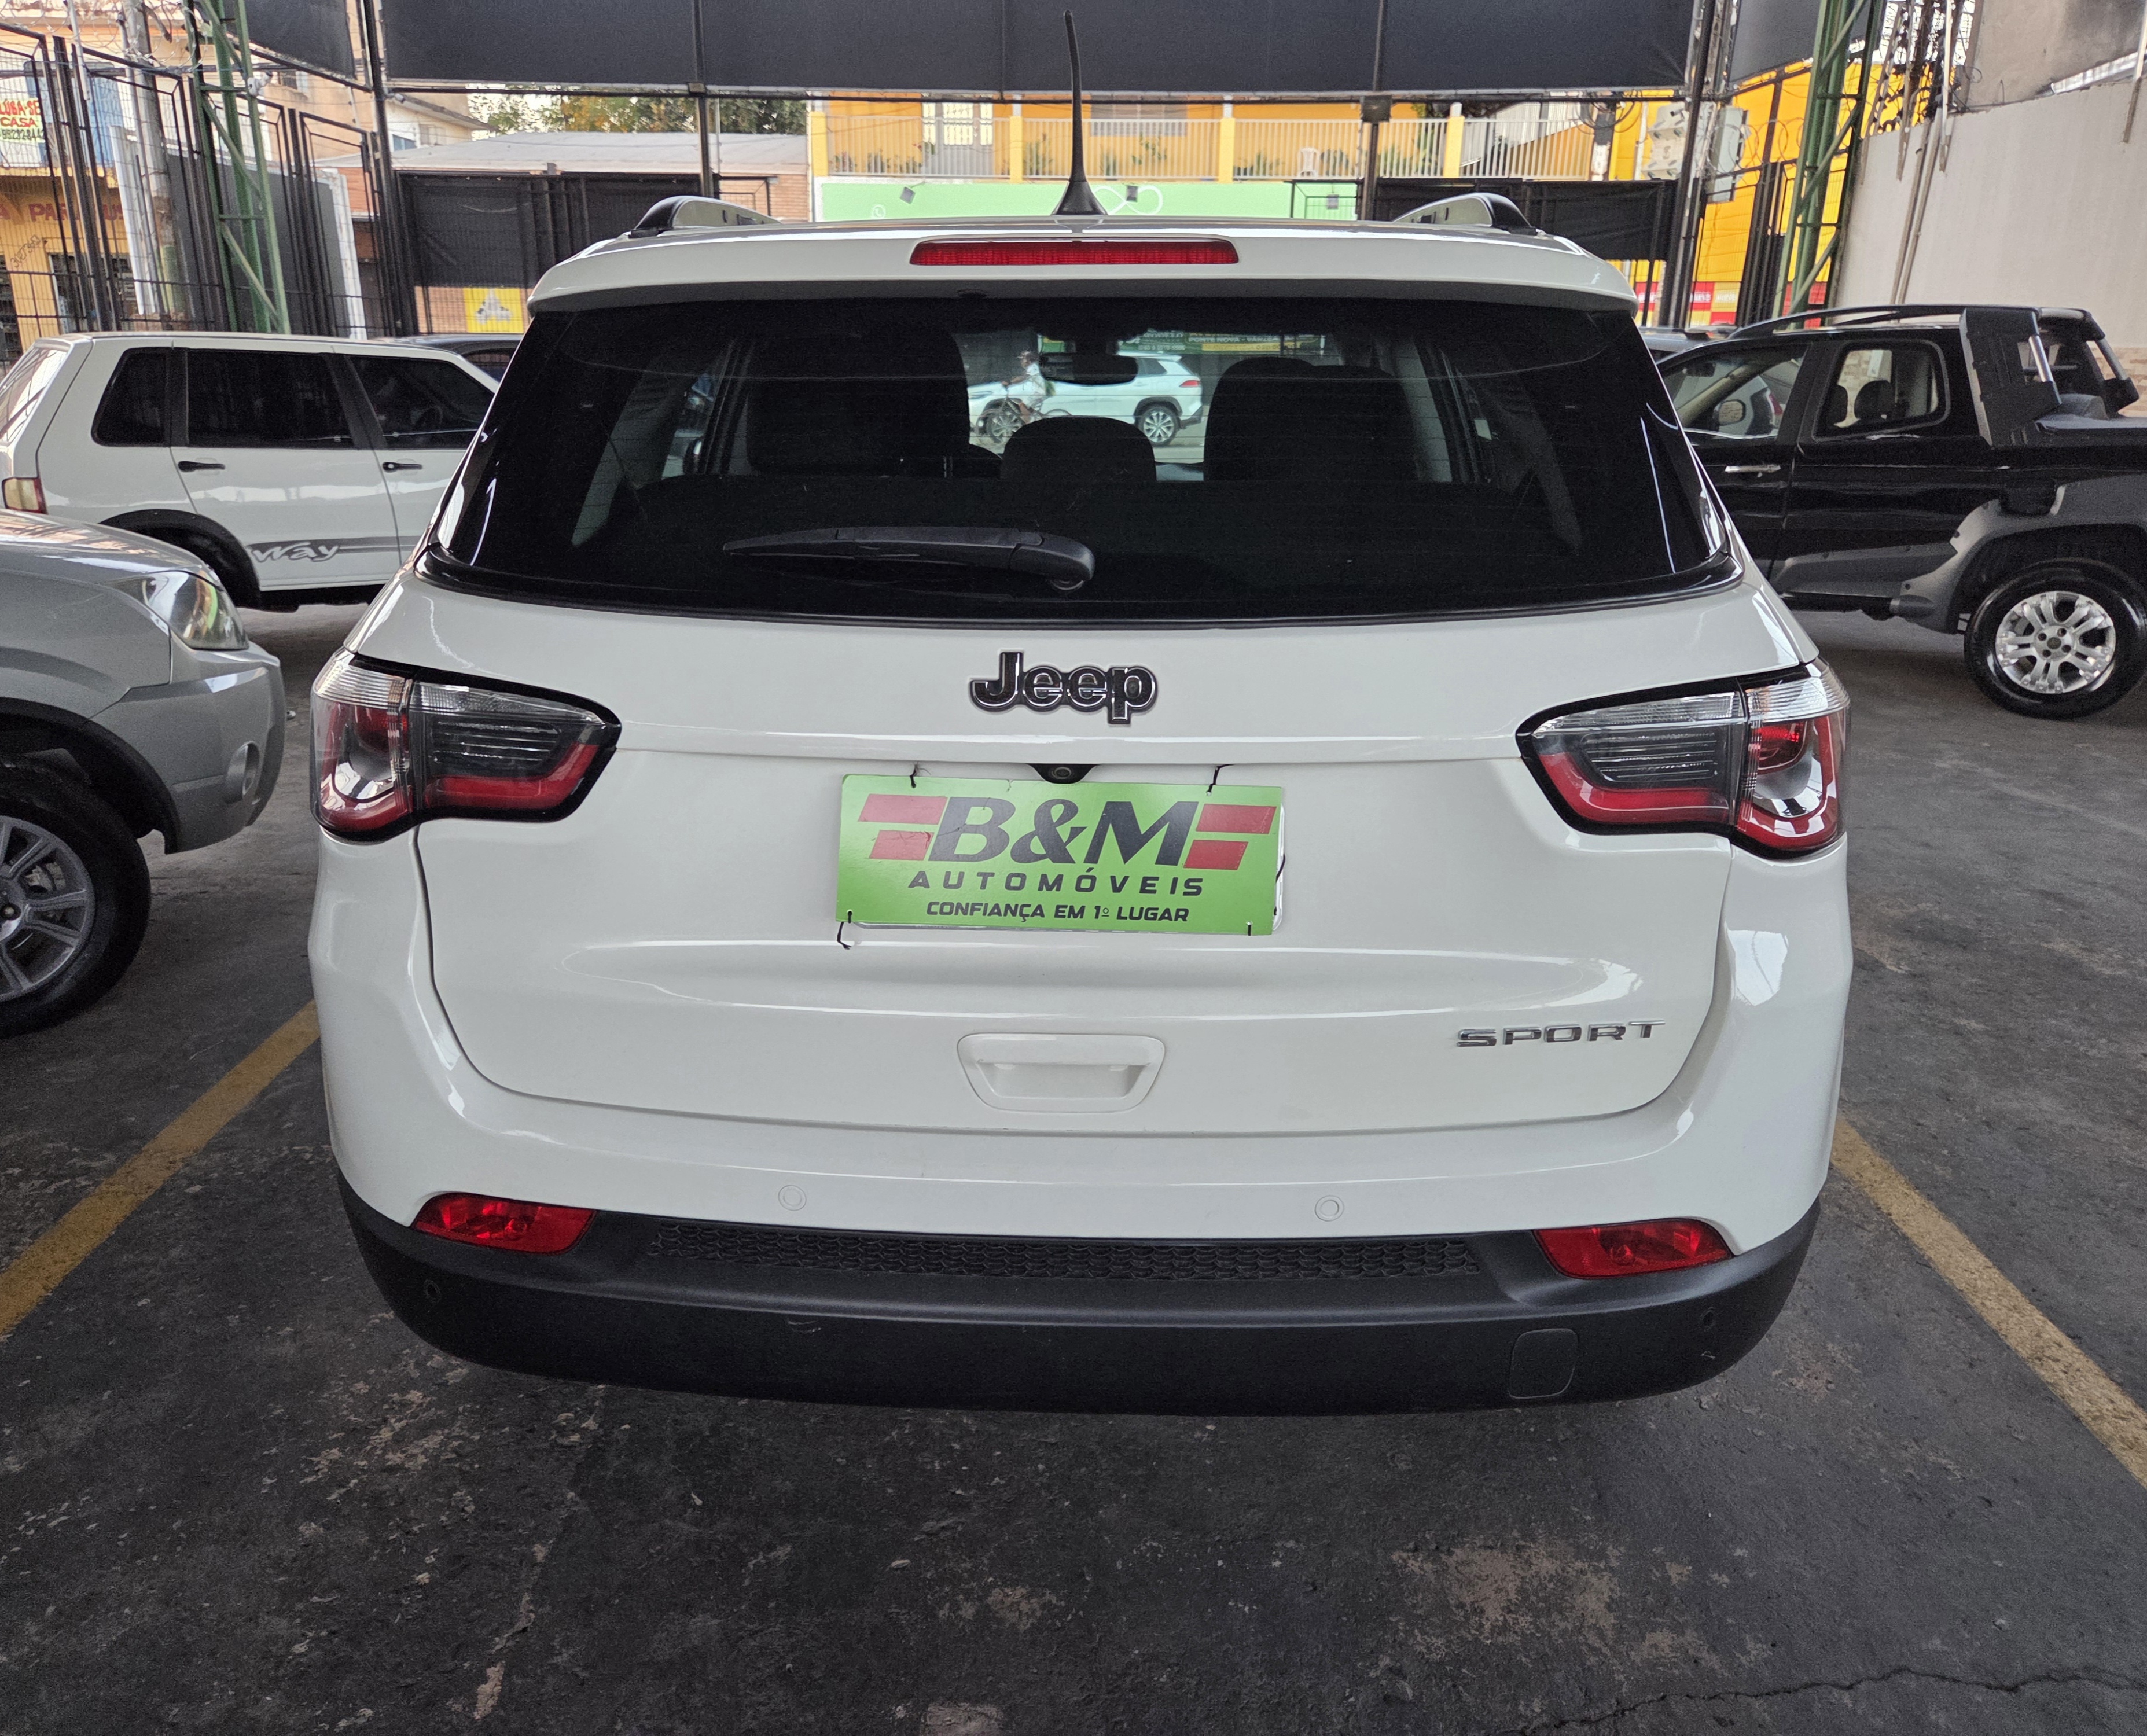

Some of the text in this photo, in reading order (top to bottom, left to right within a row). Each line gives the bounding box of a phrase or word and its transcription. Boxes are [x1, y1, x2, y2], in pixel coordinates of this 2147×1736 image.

[0, 117, 38, 127] CASA
[969, 652, 1158, 724] Jeep
[928, 796, 1199, 866] B&M
[907, 867, 1204, 896] AUTOMÓVEIS
[927, 902, 1045, 922] CONFIANÇA
[1054, 904, 1086, 919] EM
[1116, 906, 1189, 922] LUGAR
[1456, 1020, 1666, 1047] SPORT
